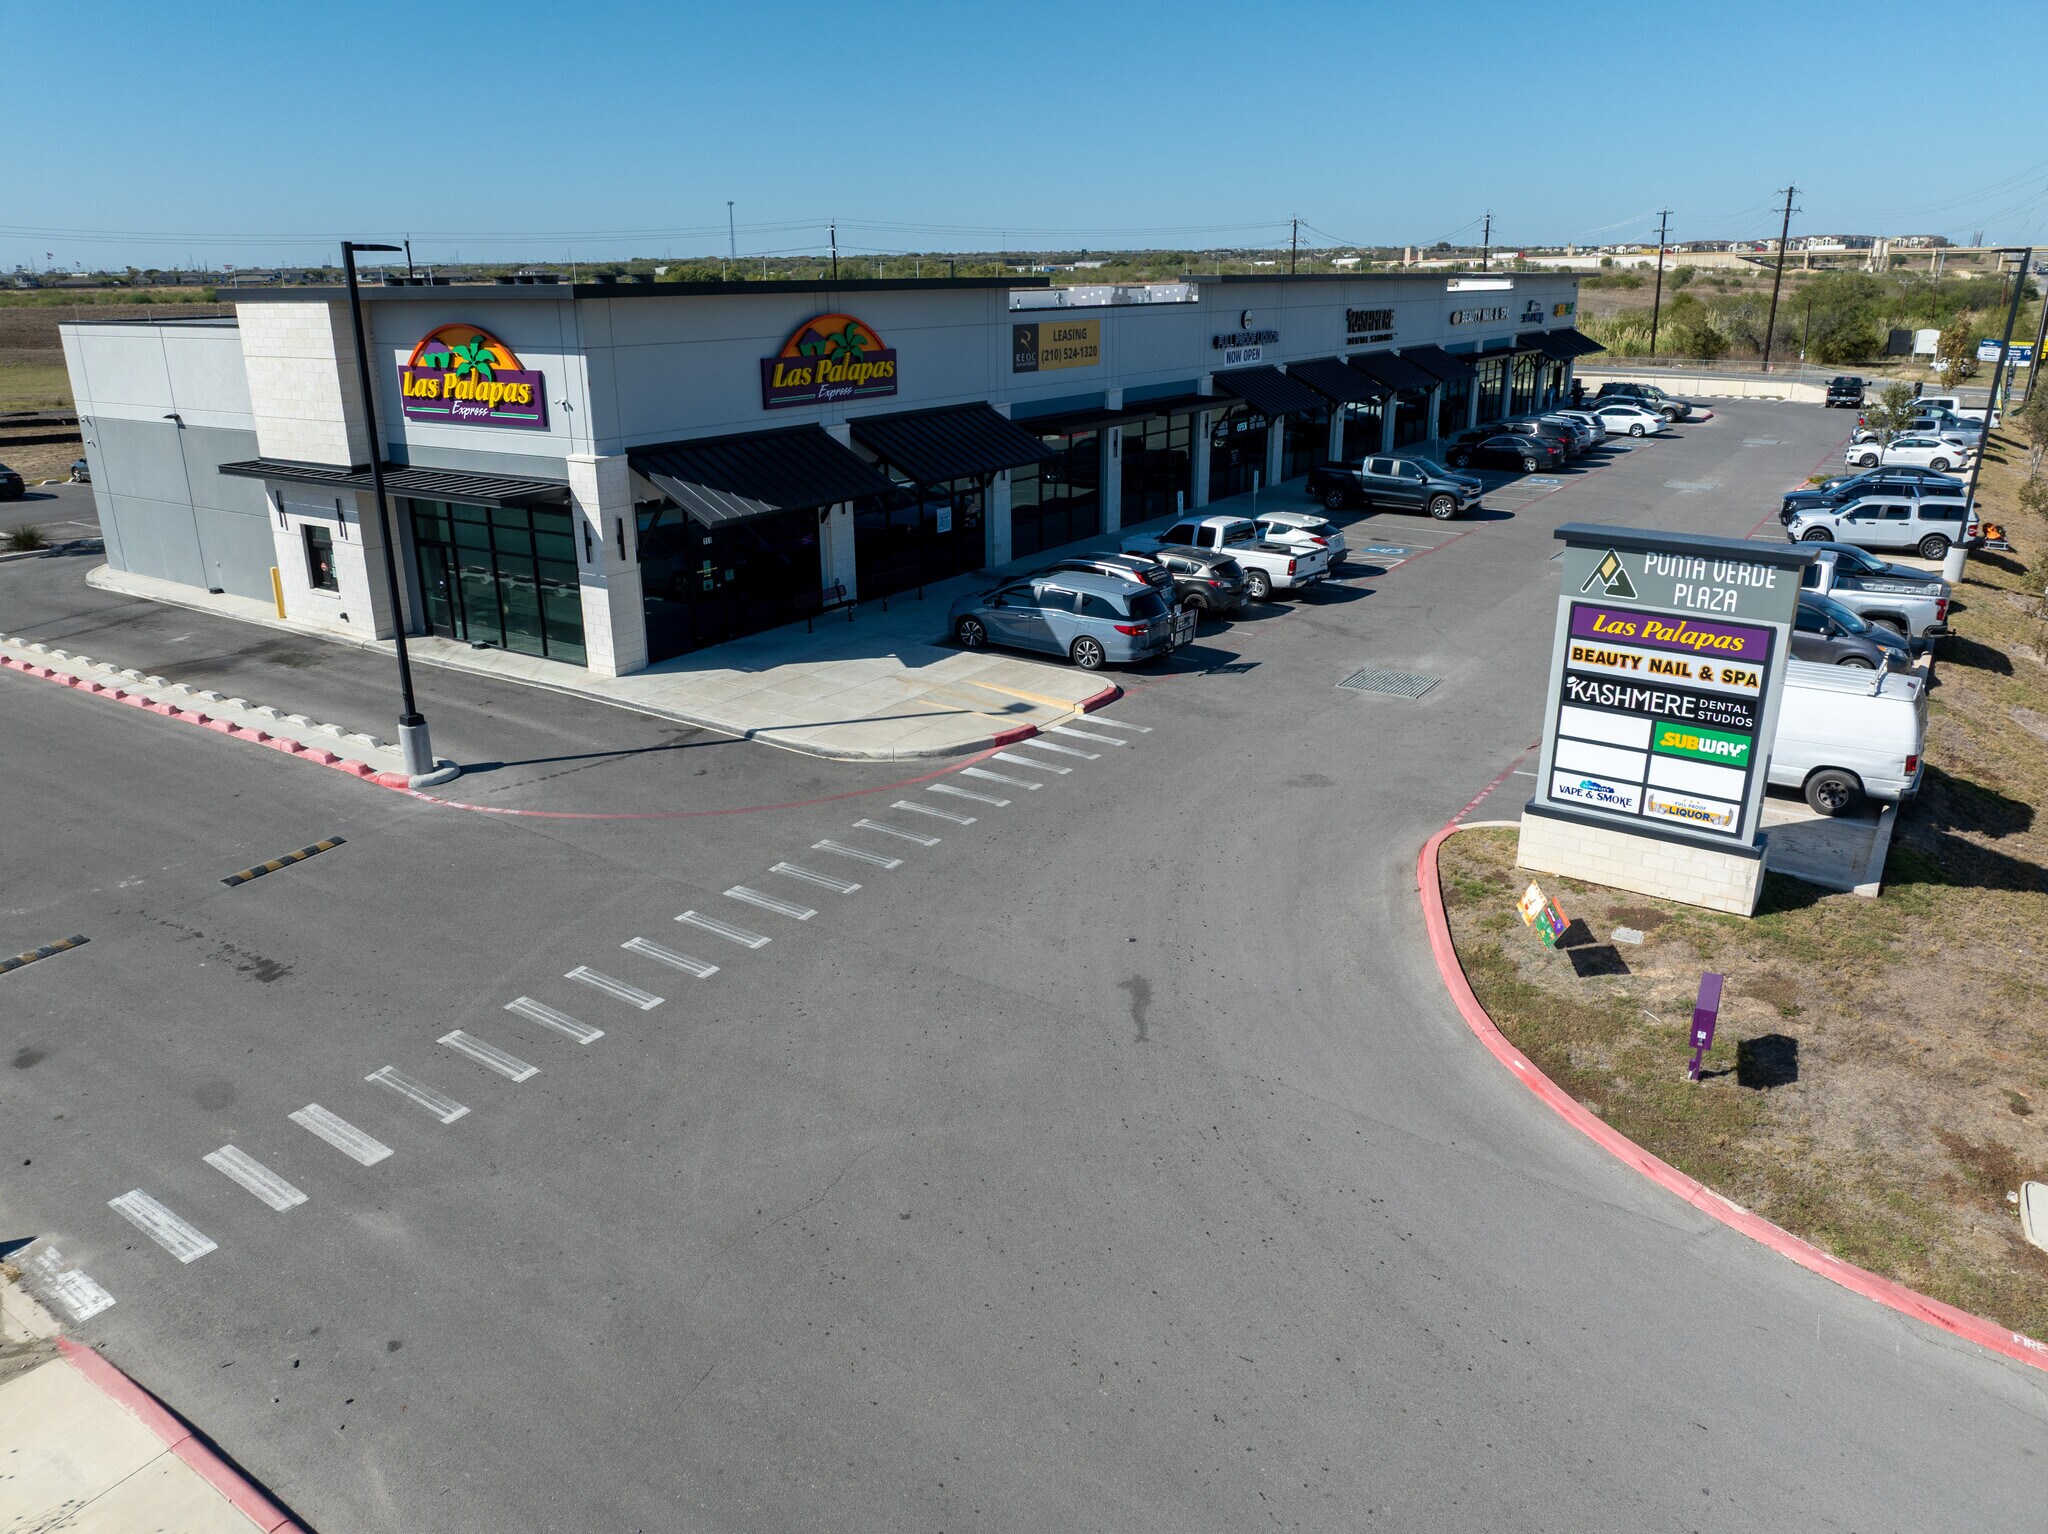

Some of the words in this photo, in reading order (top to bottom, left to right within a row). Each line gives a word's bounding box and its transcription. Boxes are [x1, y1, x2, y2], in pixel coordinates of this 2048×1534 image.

[1053, 328, 1087, 342] LEASING
[1016, 352, 1037, 362] REOC
[1041, 347, 1062, 364] (210)
[1063, 345, 1098, 360] 524-1320
[1226, 350, 1242, 364] NOW
[1243, 348, 1260, 362] OPEN
[772, 362, 811, 388] Las
[815, 352, 895, 385] Palapas
[403, 371, 441, 398] Las
[443, 368, 532, 408] Palapas
[818, 384, 853, 401] Express
[452, 401, 488, 419] Express
[1643, 551, 1707, 581] PUNTA
[1712, 558, 1778, 589] VERDE
[1673, 583, 1738, 613] PLAZA
[1592, 614, 1637, 637] Las
[1641, 621, 1745, 652] Palapas
[1571, 646, 1643, 671] BEAUTY
[1649, 658, 1693, 679] NAIL
[1699, 665, 1715, 682] &
[1721, 669, 1759, 690] SPA
[1567, 677, 1696, 719] KASHMERE
[1699, 699, 1749, 716] DENTAL
[1697, 711, 1754, 728] STUDIOS
[1660, 731, 1748, 757] SUBWAY
[1559, 784, 1583, 797] VAPE
[1585, 791, 1594, 799] &
[1596, 793, 1633, 809] SMOKE
[1668, 806, 1711, 822] LIQUOR
